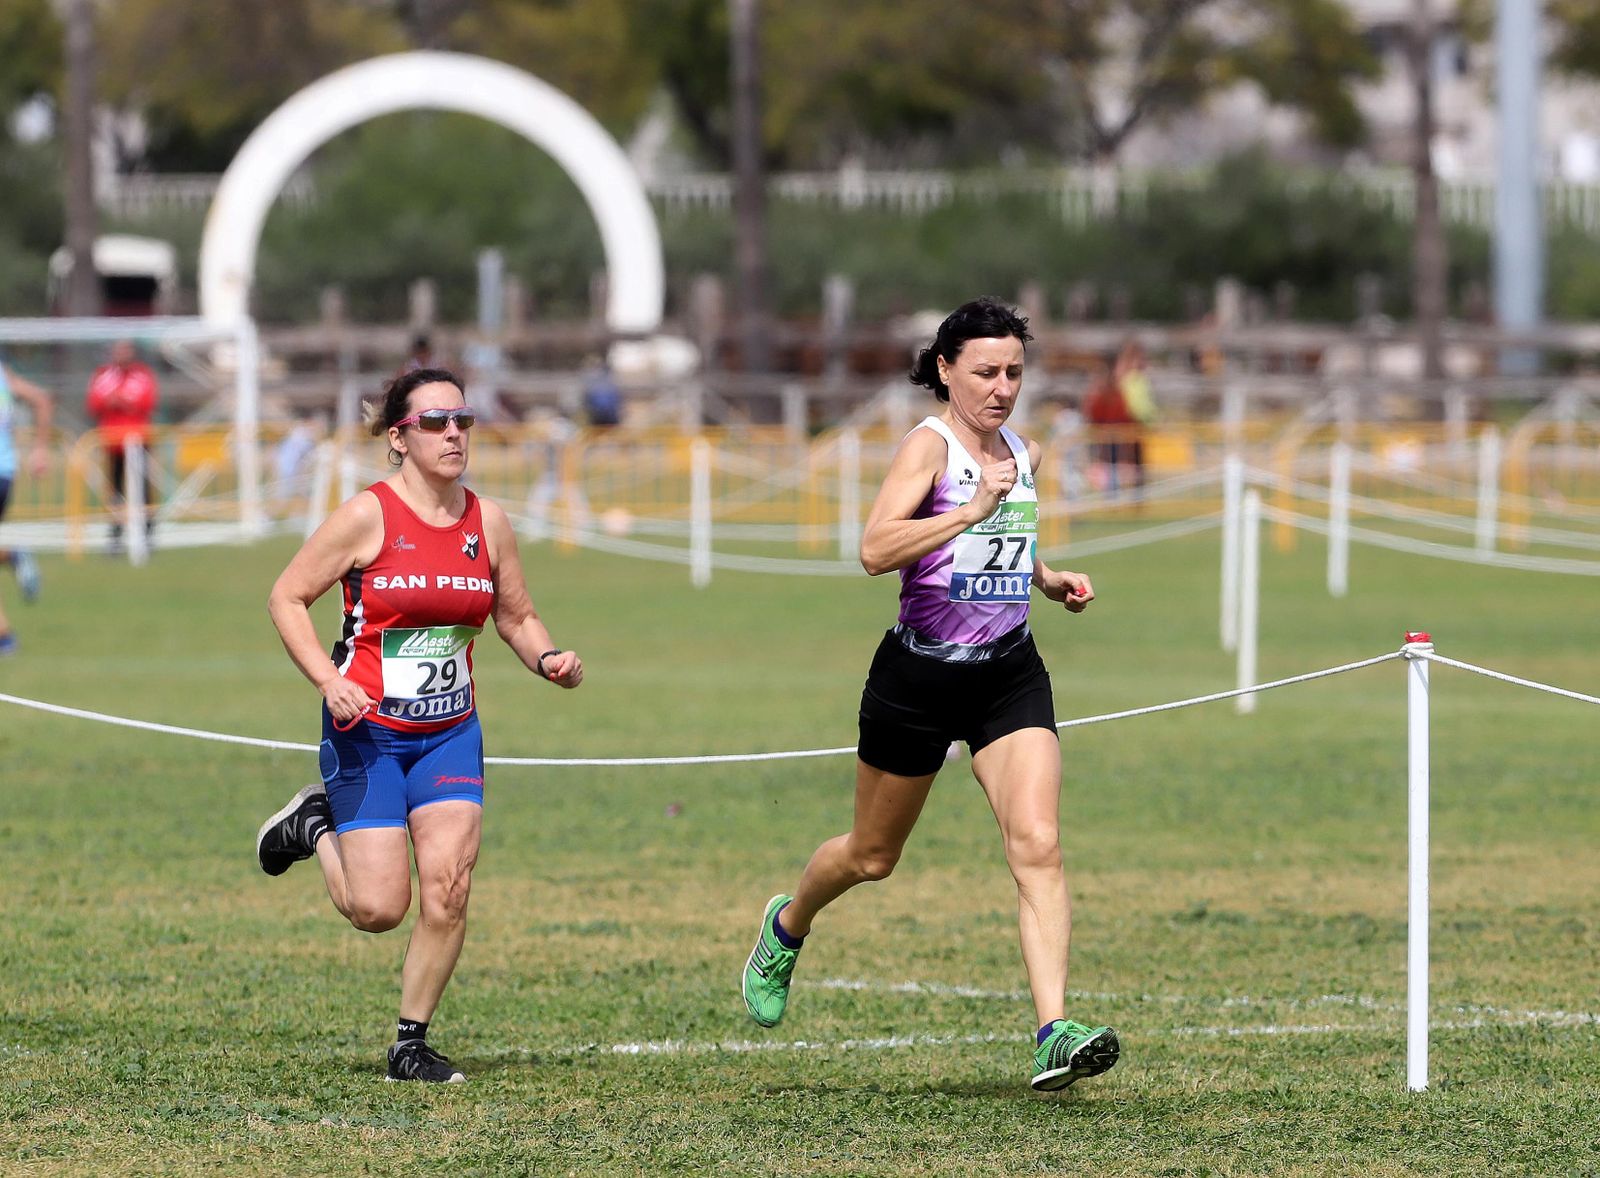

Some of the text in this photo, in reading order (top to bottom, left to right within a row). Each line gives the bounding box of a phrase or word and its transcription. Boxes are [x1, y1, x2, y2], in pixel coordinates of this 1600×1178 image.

[983, 536, 1027, 571] 27
[372, 575, 495, 594] SAN PEDR
[416, 658, 459, 695] 29
